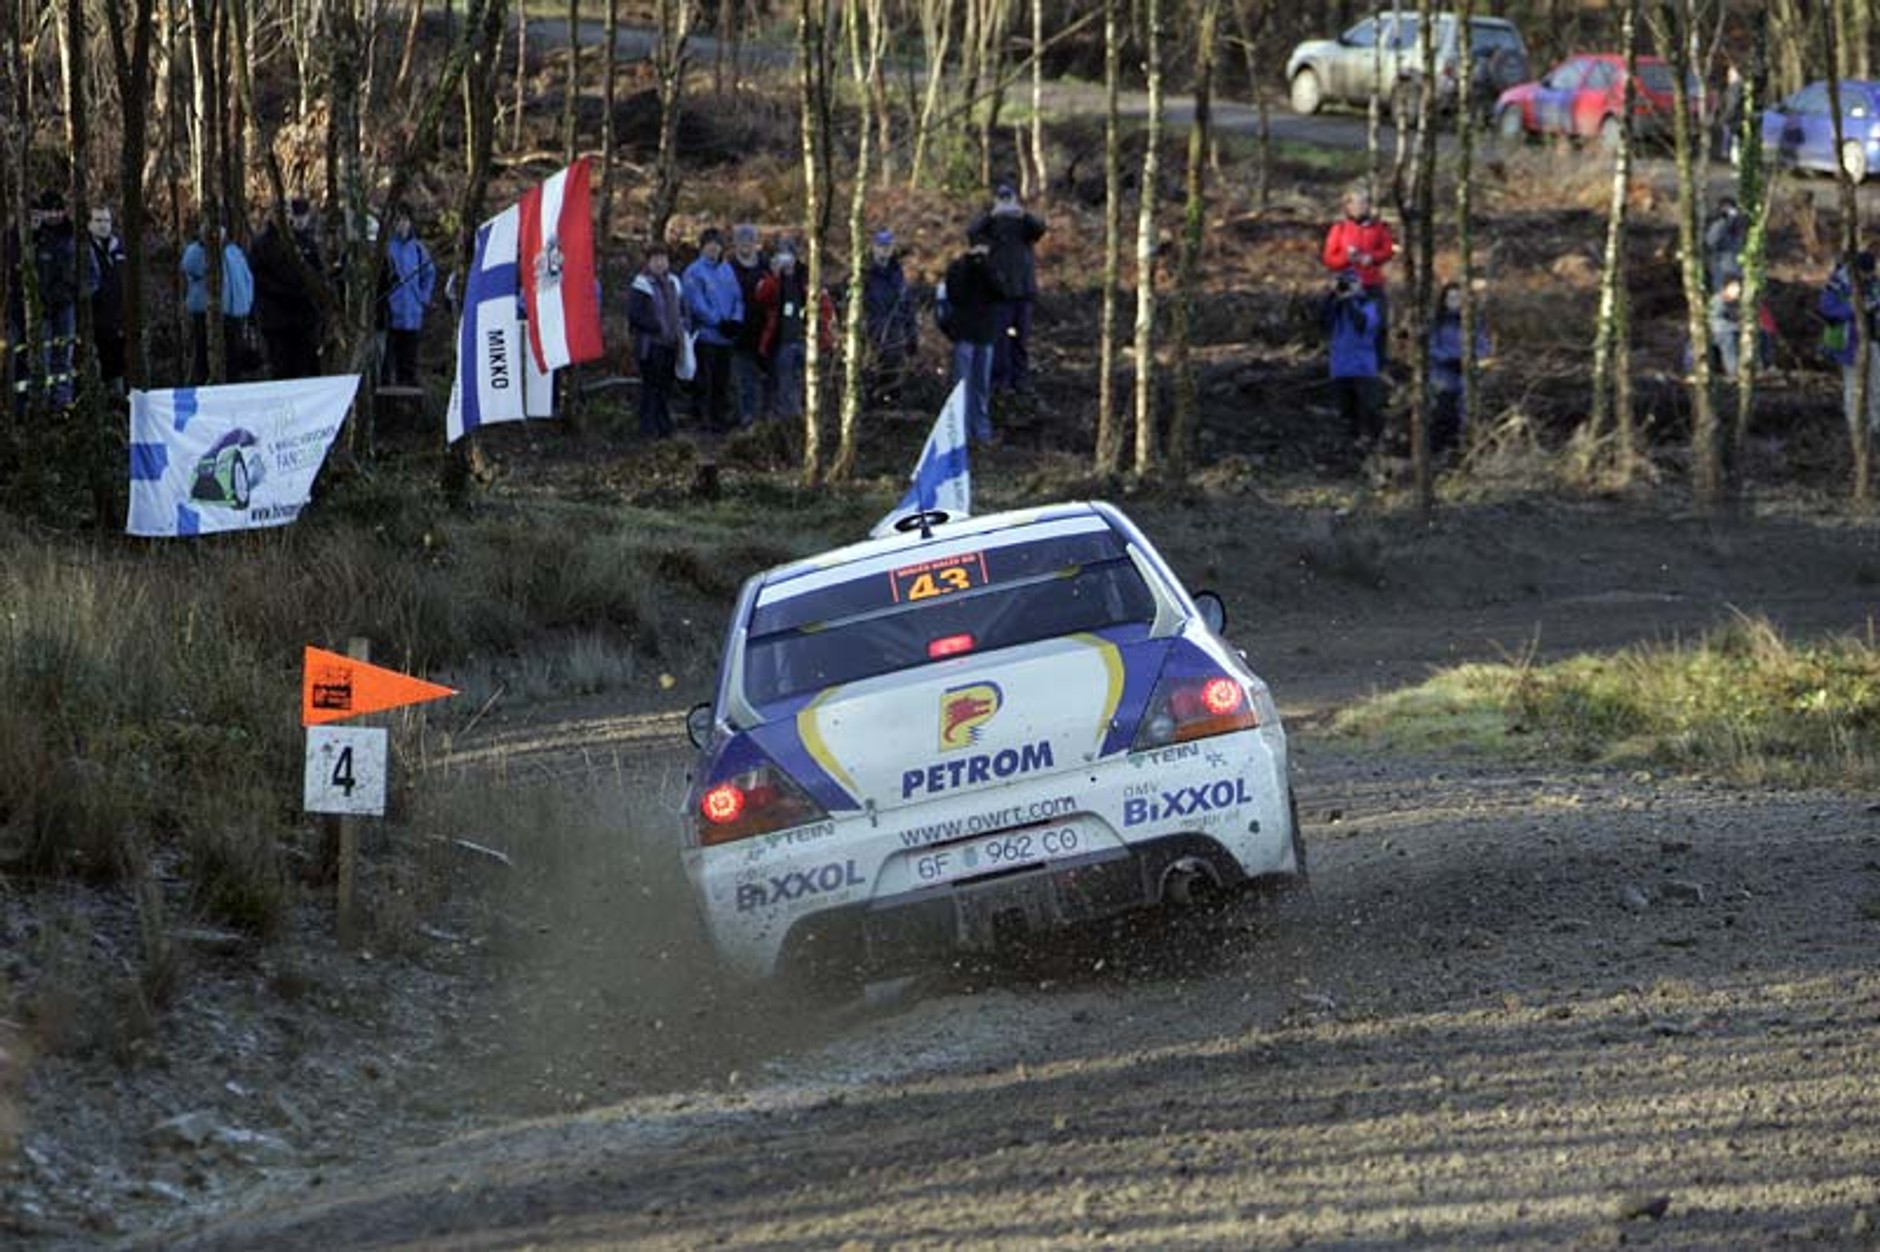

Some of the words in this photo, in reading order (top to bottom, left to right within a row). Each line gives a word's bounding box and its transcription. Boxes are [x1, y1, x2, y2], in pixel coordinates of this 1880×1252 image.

[488, 329, 509, 389] MIKKO
[909, 567, 970, 600] 43
[332, 746, 356, 797] 4
[902, 740, 1054, 799] PETROM
[1146, 742, 1199, 765] TEIN
[899, 796, 1077, 847] www.owrt.com
[985, 835, 1034, 864] 962
